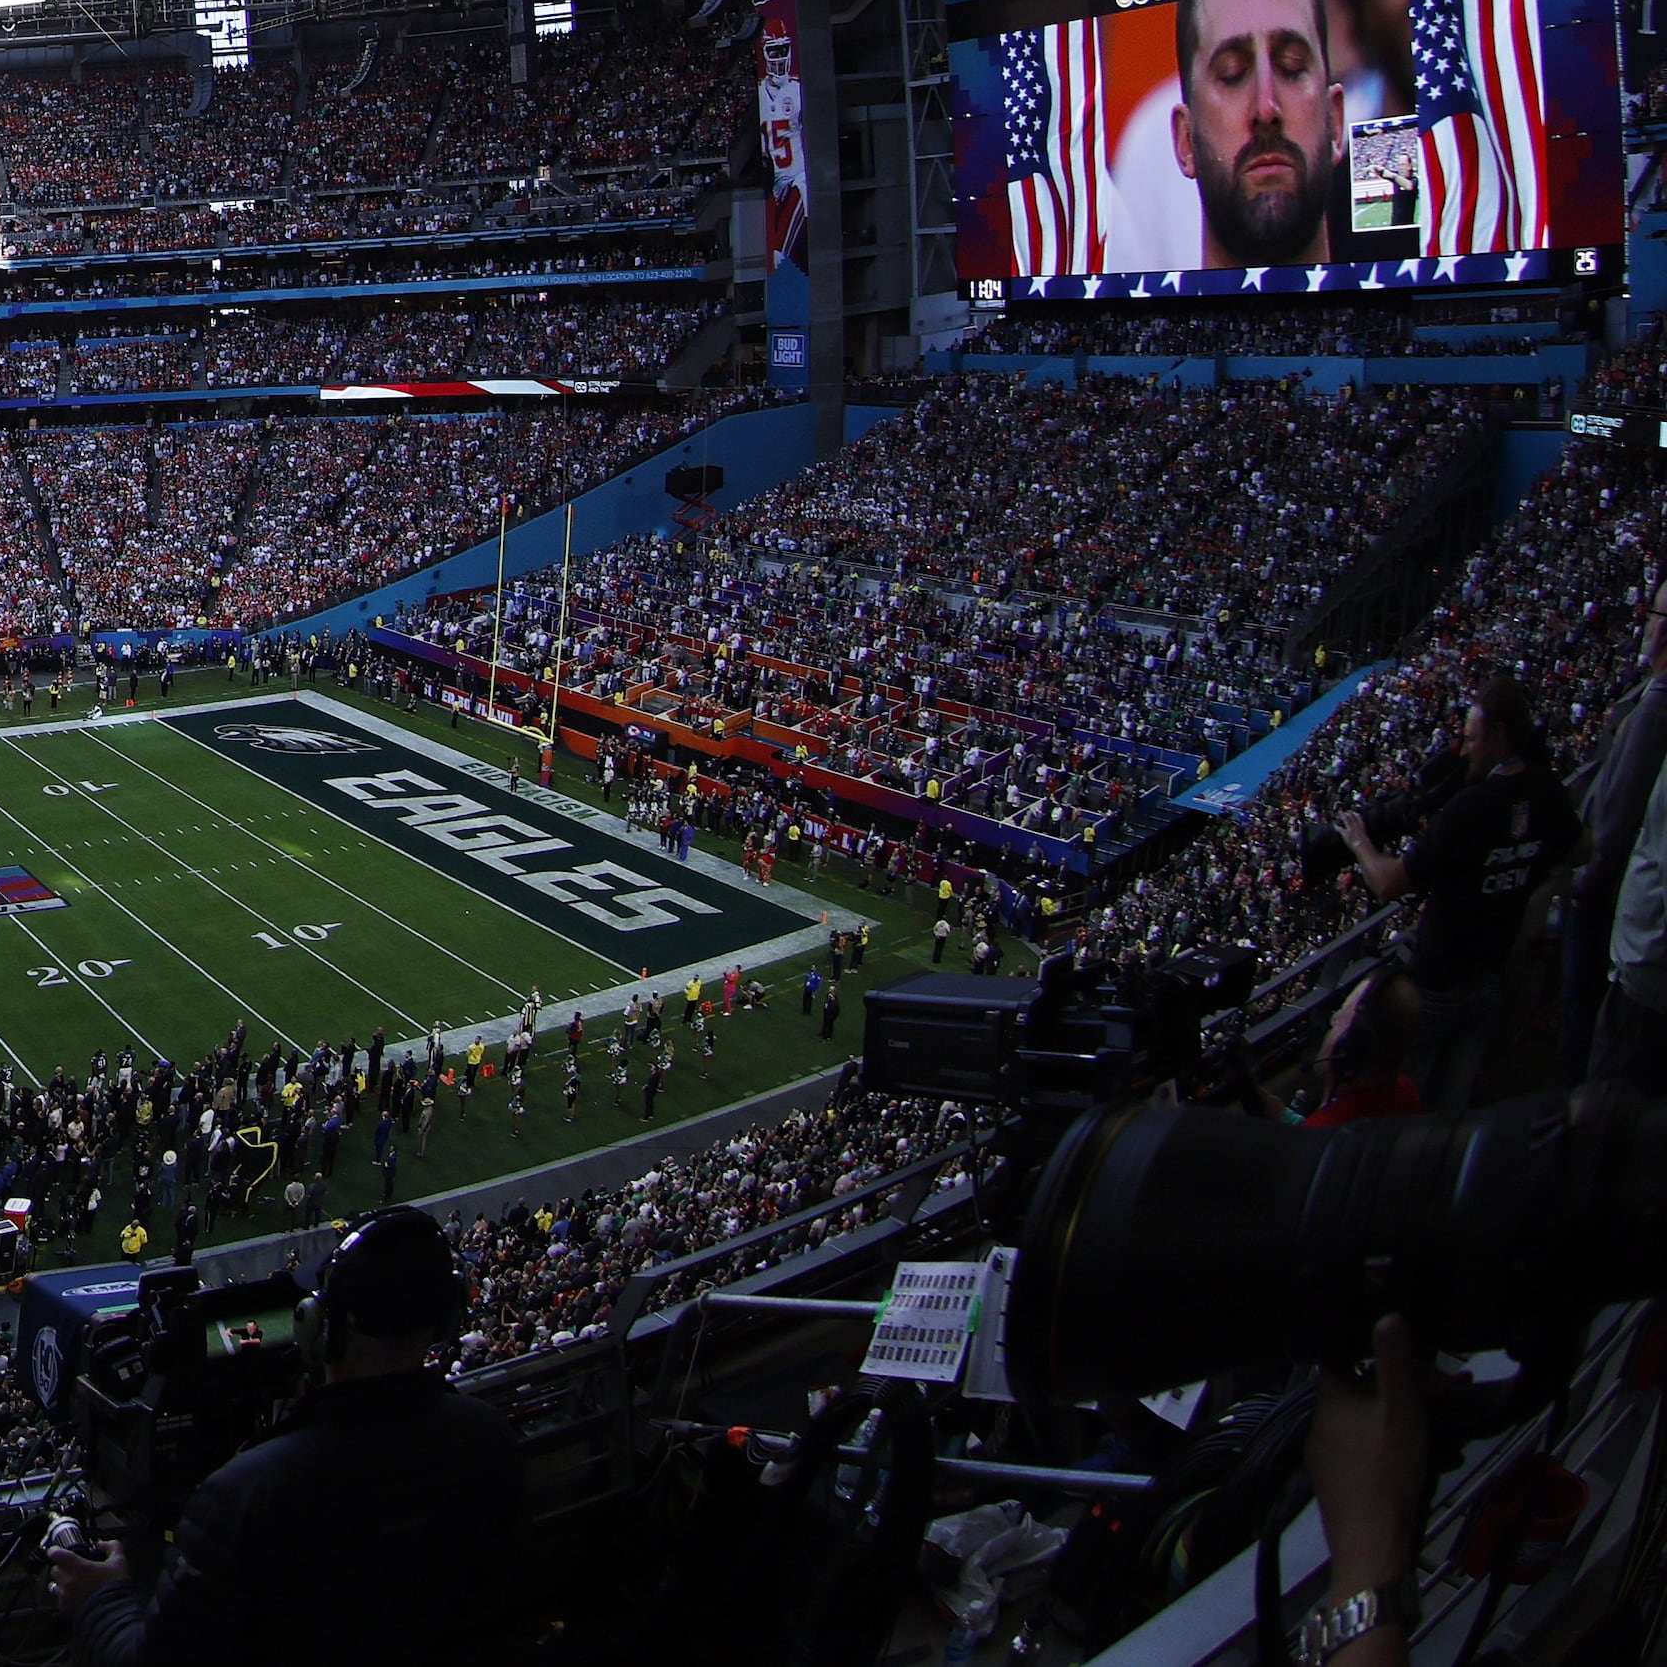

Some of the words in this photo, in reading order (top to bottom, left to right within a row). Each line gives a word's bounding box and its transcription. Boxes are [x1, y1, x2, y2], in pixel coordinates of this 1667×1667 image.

[1575, 250, 1596, 272] 25
[969, 279, 1003, 299] 11:04
[776, 337, 799, 352] BUD
[773, 351, 804, 368] LIGHT
[458, 761, 509, 782] END
[322, 767, 724, 932] EAGLES
[250, 922, 331, 950] 10
[25, 957, 115, 987] 20
